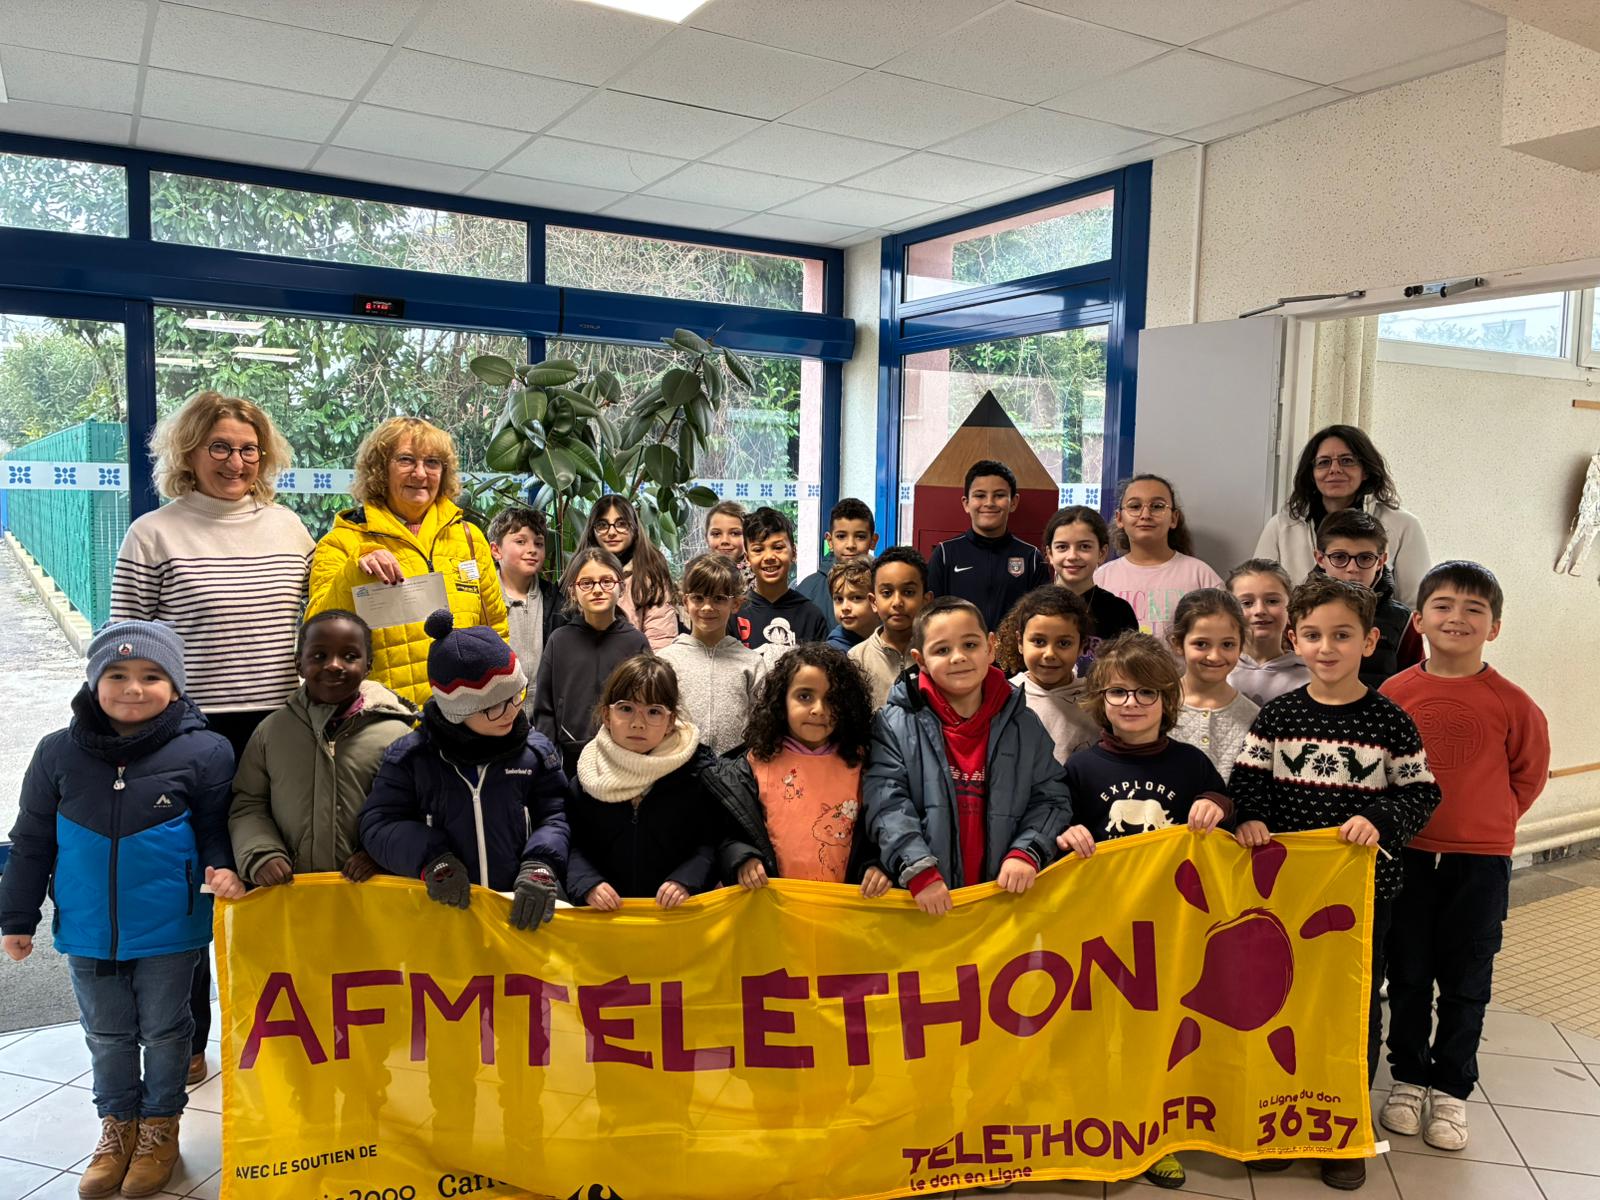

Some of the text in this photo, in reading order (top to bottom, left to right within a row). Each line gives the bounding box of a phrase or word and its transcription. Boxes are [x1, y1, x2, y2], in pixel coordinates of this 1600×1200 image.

[1100, 780, 1177, 802] EXPLORE
[1259, 1089, 1342, 1109] la Ligne du don
[1257, 1104, 1358, 1149] 3637
[236, 1144, 378, 1180] AVEC LE SOUTIEN DE
[910, 1165, 1033, 1192] le don en Ligne
